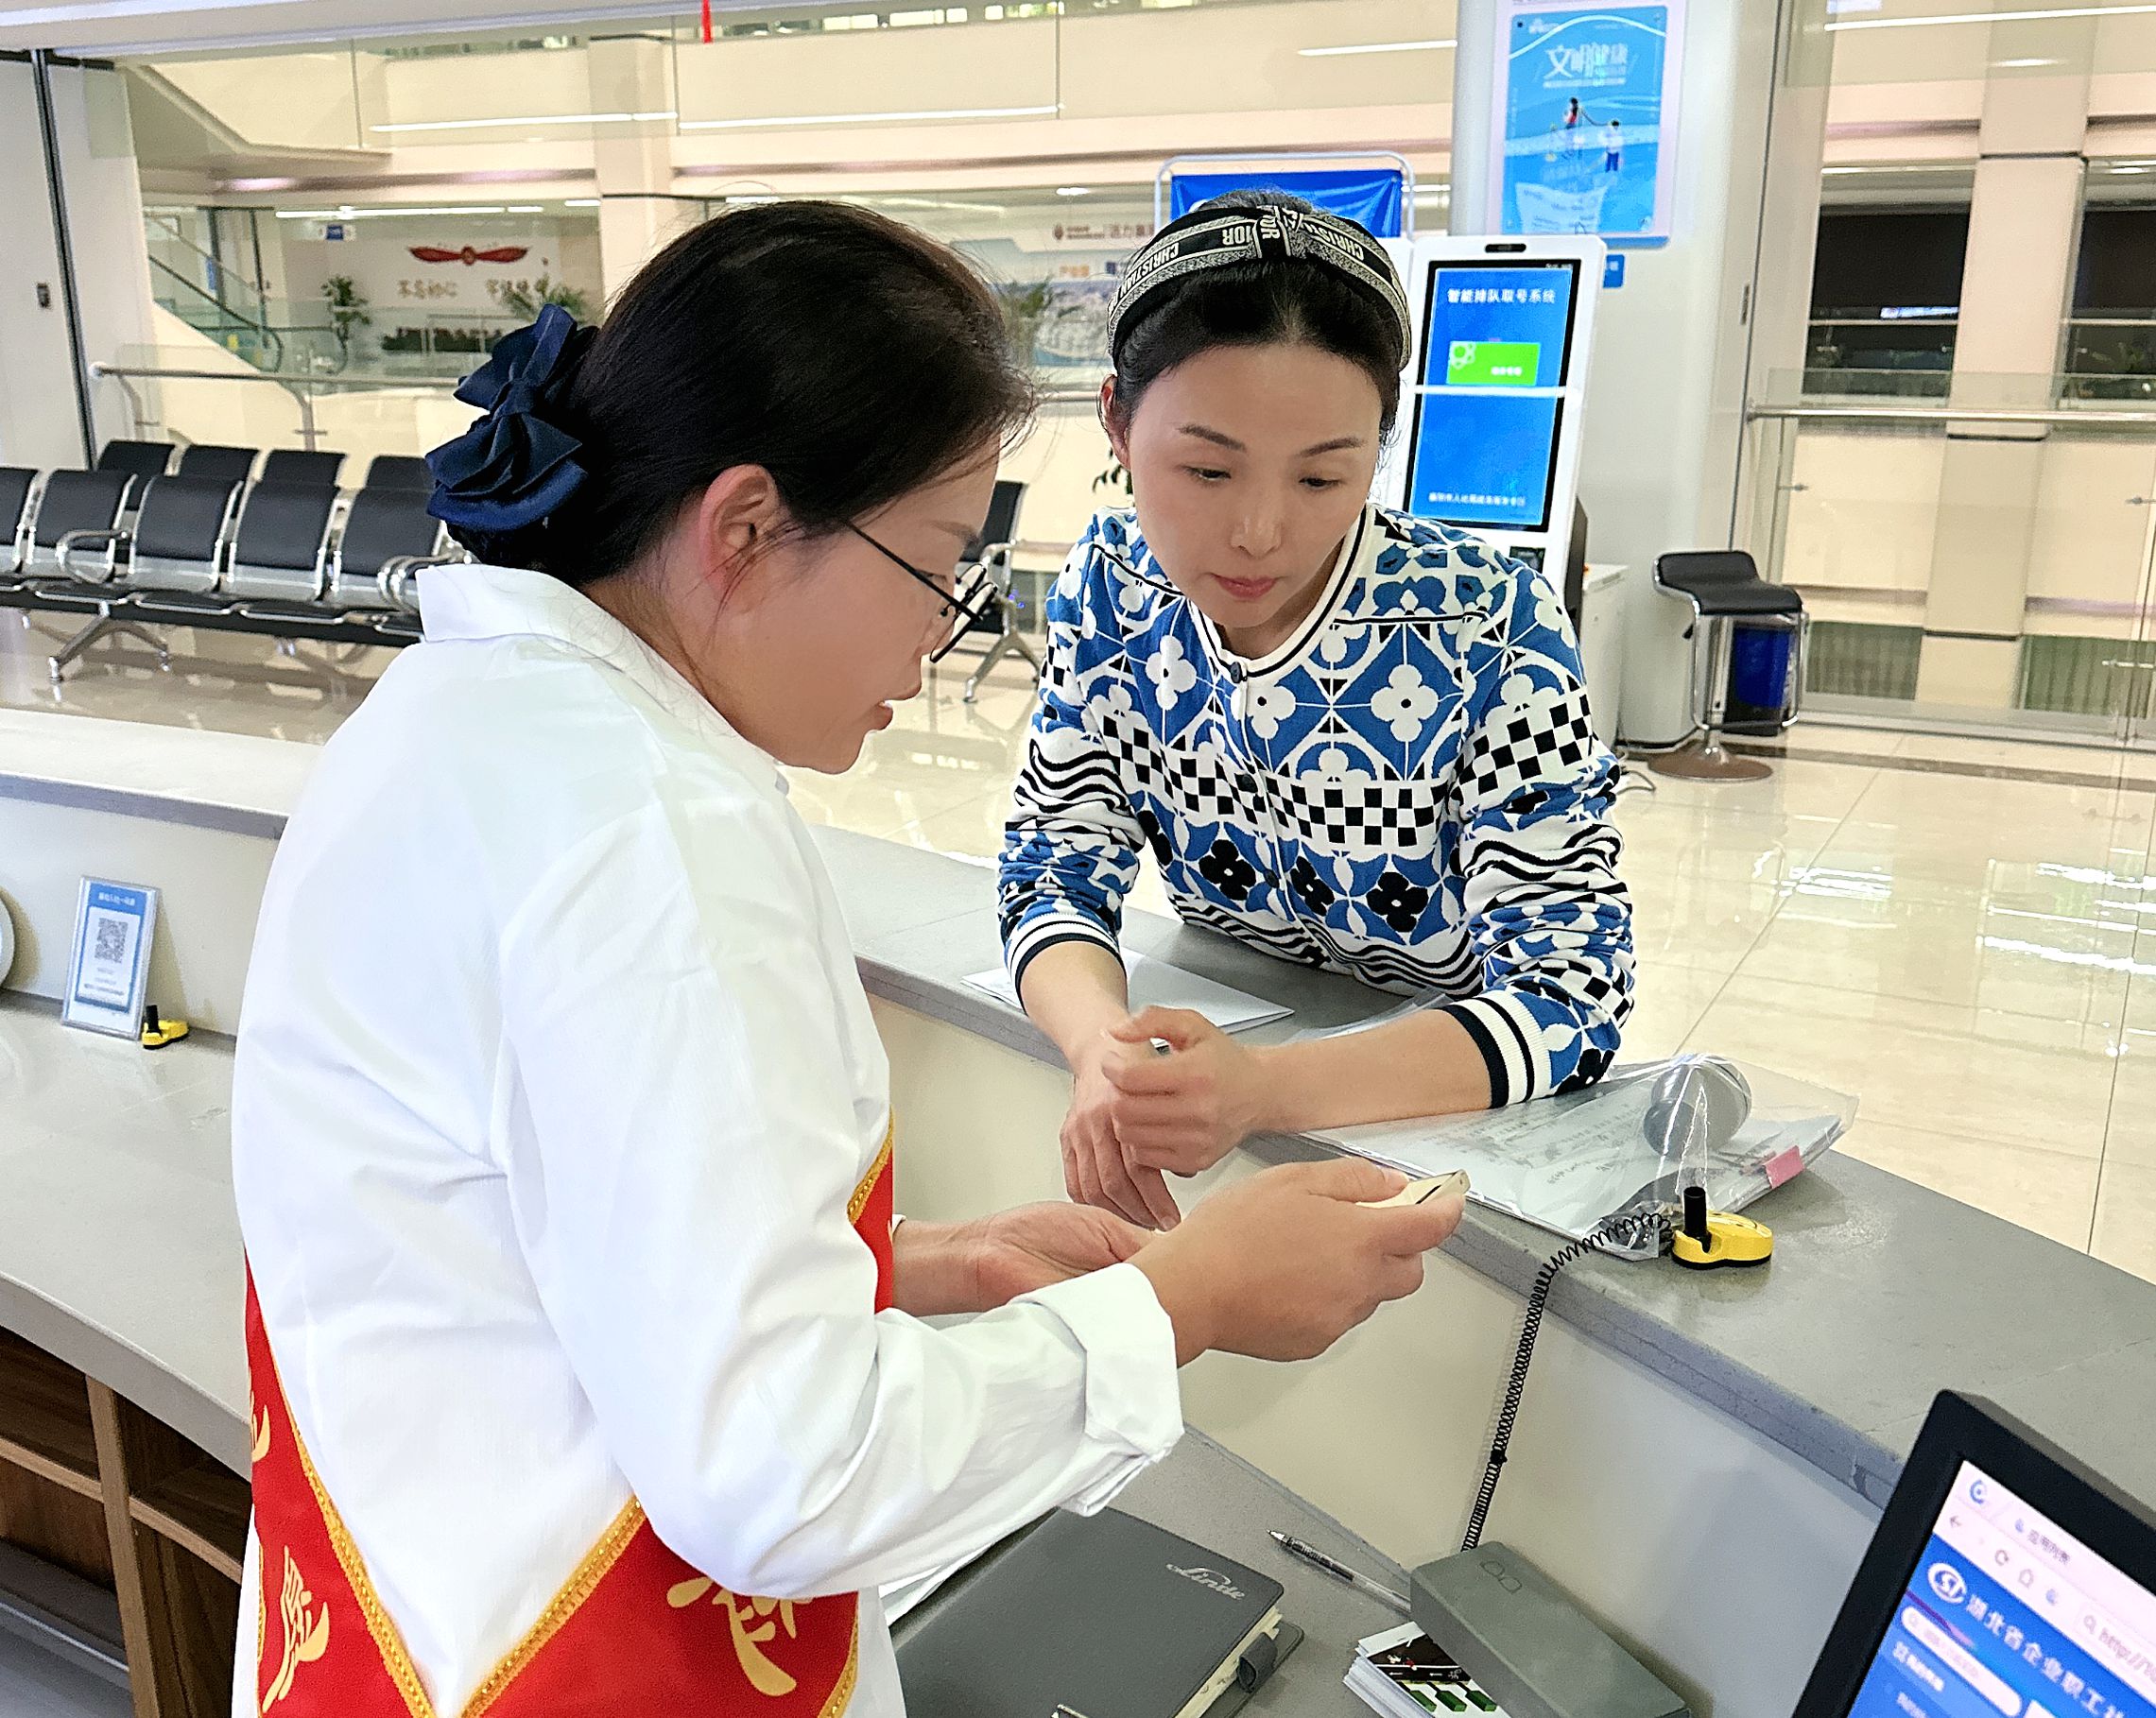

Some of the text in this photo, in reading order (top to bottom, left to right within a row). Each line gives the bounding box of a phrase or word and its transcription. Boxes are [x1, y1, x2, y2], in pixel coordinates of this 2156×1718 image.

[1447, 288, 1556, 303] 智能排队取号系统
[1165, 1563, 1246, 1600] Linde
